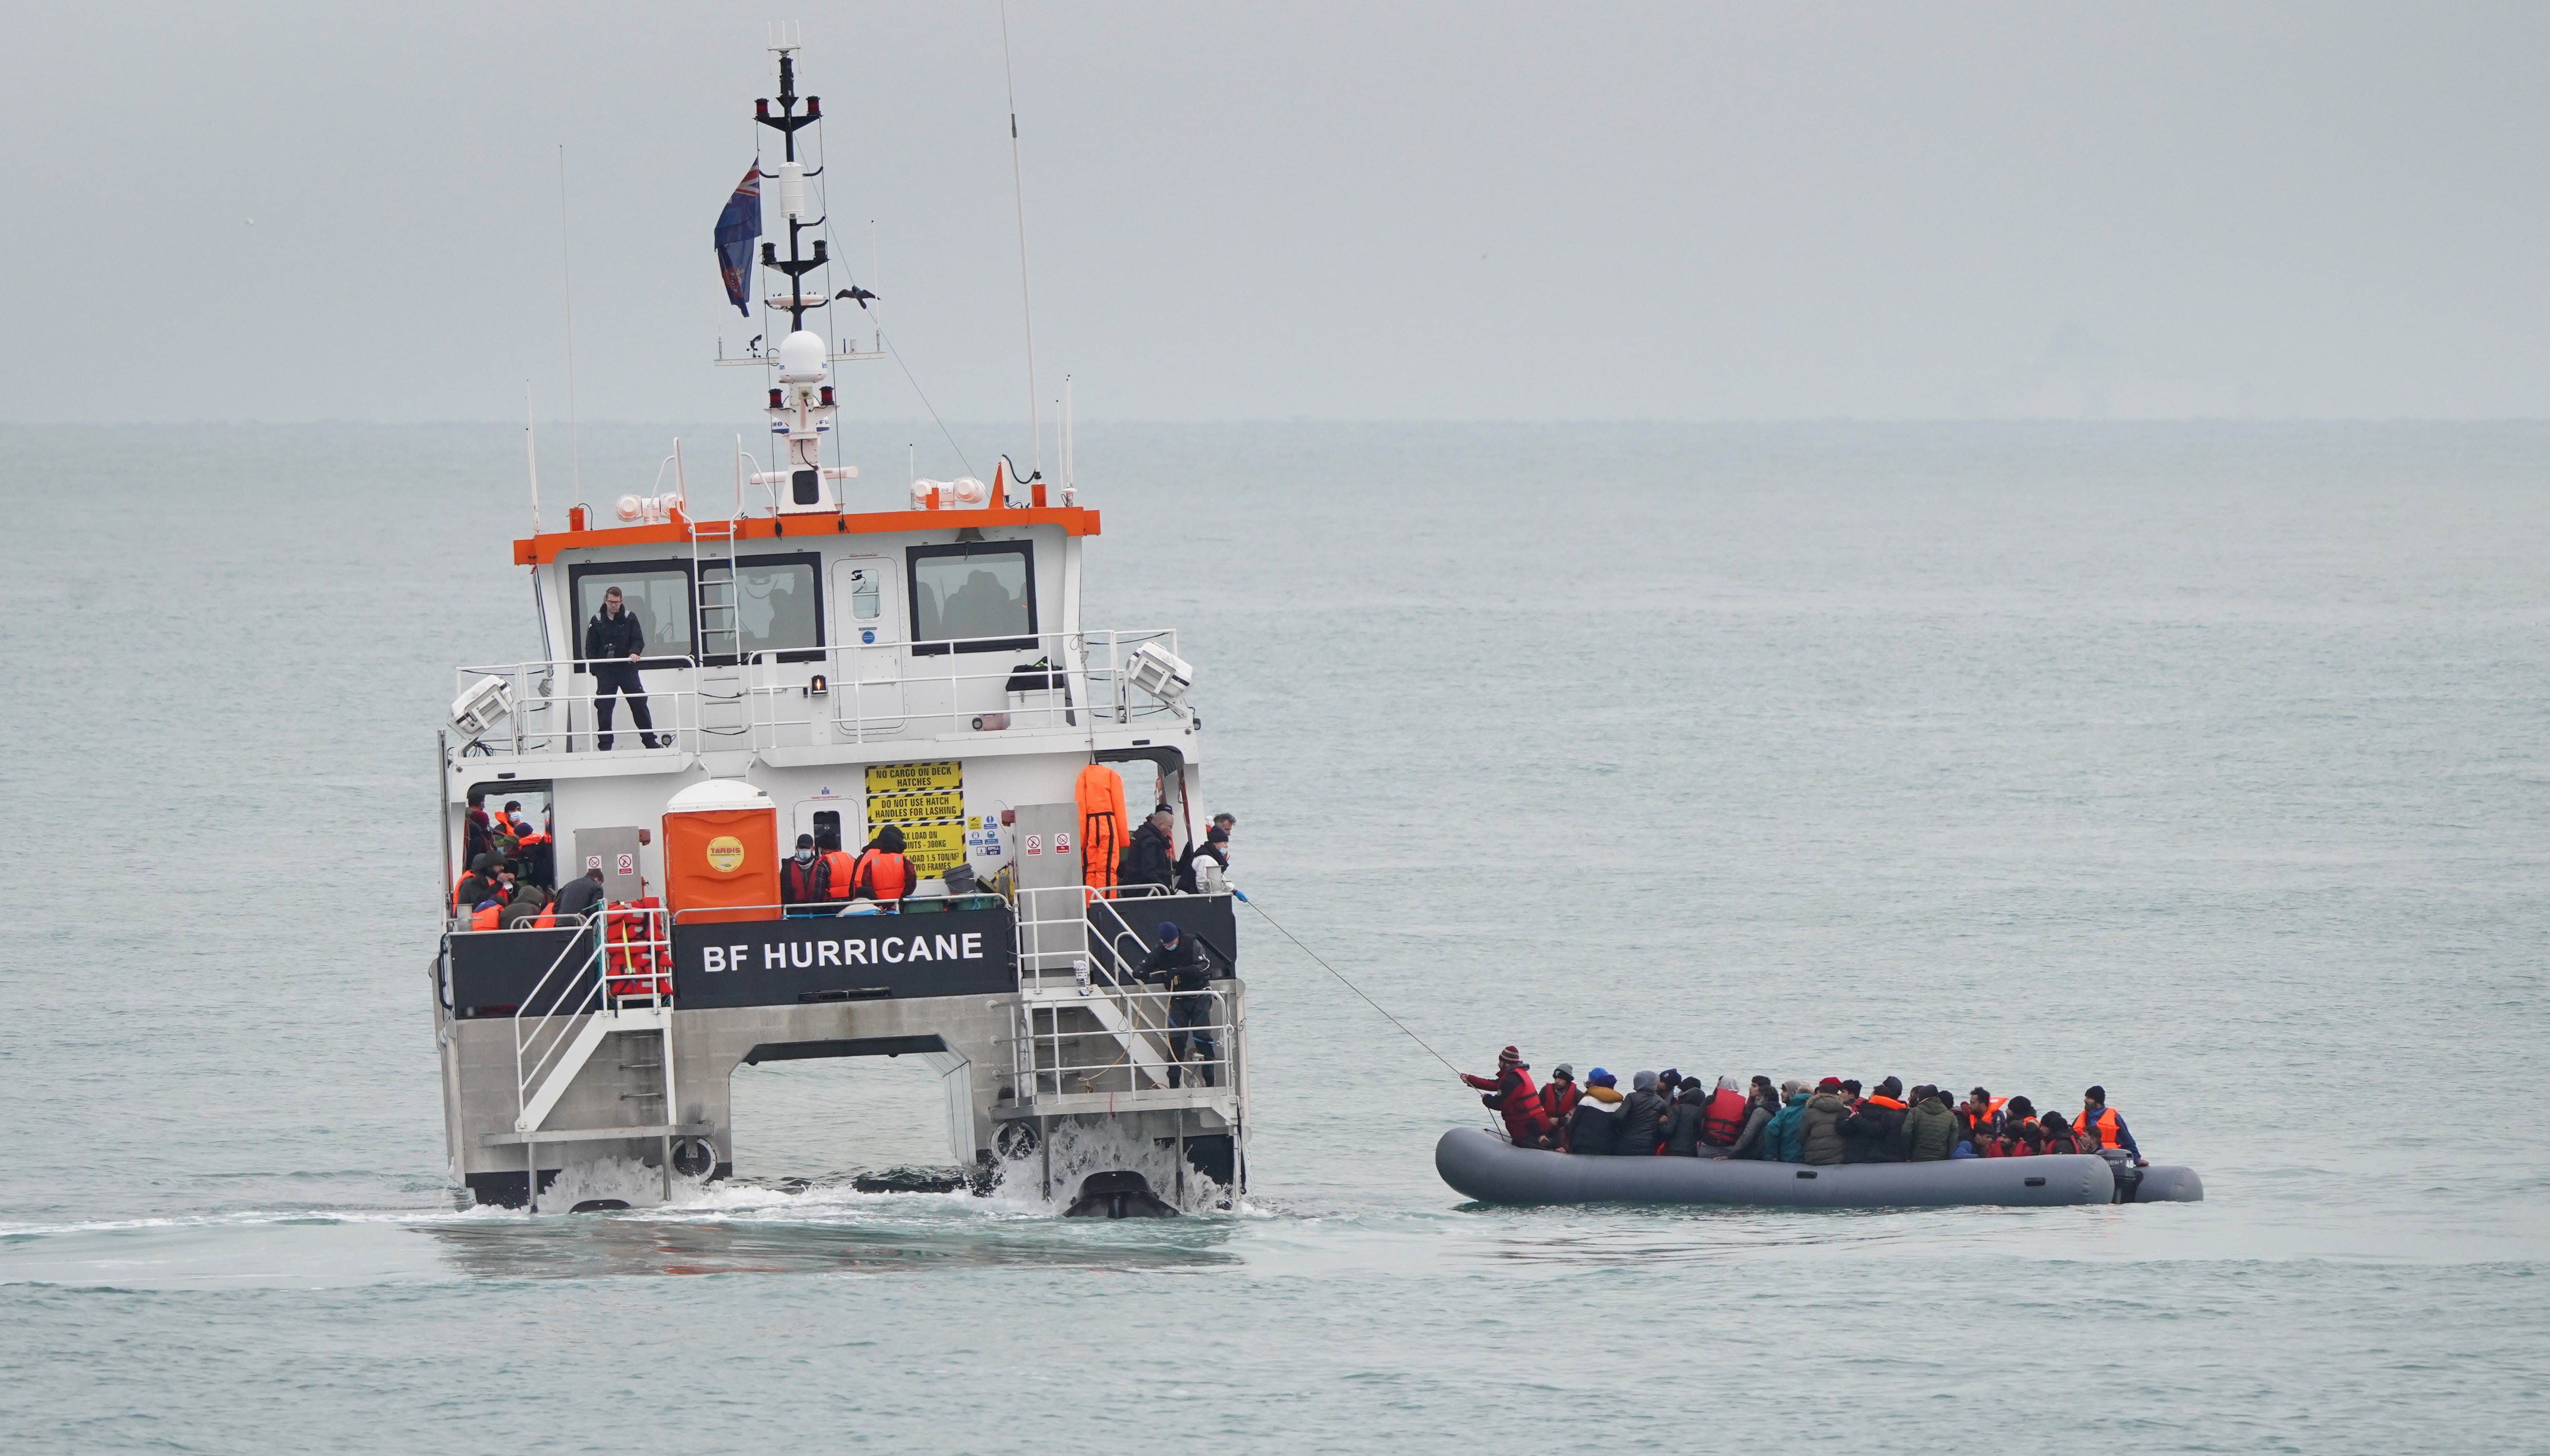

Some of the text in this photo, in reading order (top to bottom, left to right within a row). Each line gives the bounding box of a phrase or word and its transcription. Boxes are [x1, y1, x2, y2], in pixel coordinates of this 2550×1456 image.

[876, 767, 952, 778] NO CARGO ON DECK
[897, 777, 931, 787] HATCHES
[882, 797, 949, 808] DO NOT USE HATCH
[875, 806, 956, 818] HANDLES FOR LASHING
[912, 831, 927, 840] LOAD
[927, 840, 946, 848] 300KG
[927, 853, 936, 862] 1.5
[927, 862, 951, 871] FRAMES
[703, 932, 983, 972] BF HURRICANE
[2126, 1159, 2134, 1169] 40
